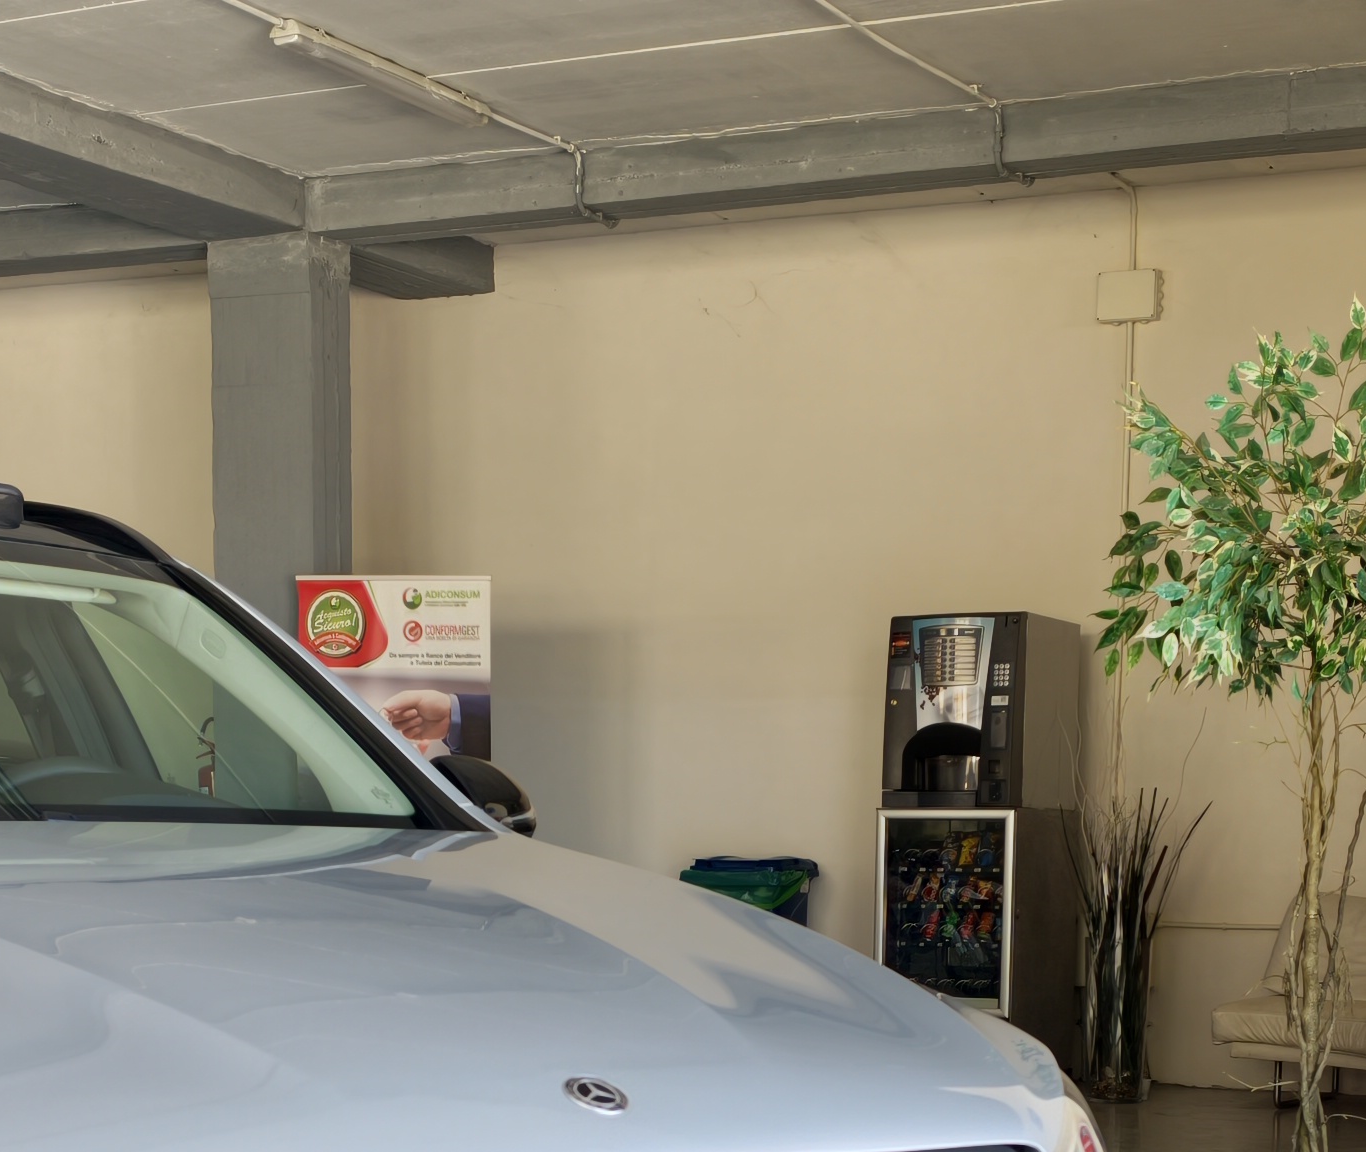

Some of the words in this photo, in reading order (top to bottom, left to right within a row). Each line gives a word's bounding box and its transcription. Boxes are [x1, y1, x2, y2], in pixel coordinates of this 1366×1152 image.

[425, 590, 481, 599] ADICONSUM
[314, 613, 357, 632] Sicuro!
[425, 625, 480, 636] CONFORMGEST
